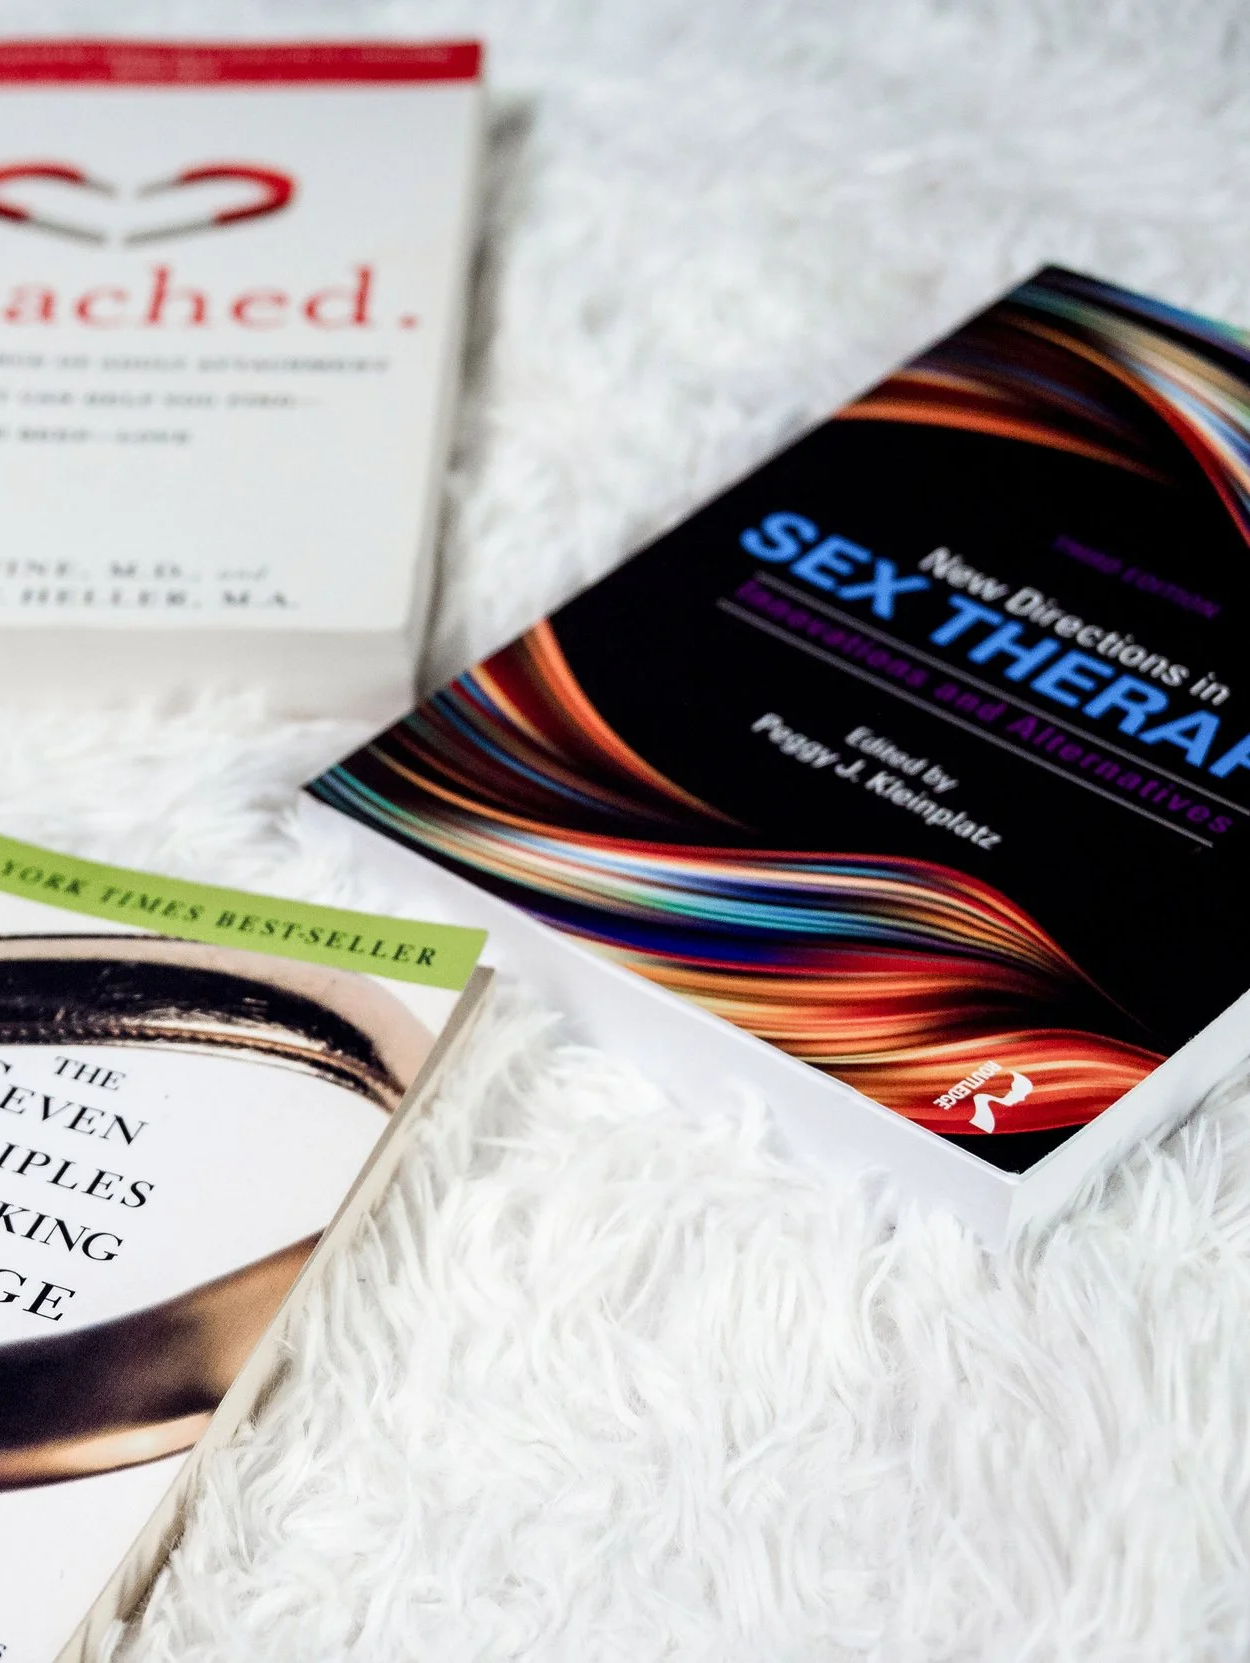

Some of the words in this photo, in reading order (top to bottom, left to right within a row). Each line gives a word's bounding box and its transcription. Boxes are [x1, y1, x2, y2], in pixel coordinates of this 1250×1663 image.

[739, 510, 932, 620] SEX
[918, 545, 1008, 601] New
[1004, 587, 1190, 689] Directions
[1189, 671, 1231, 707] in
[751, 712, 841, 769] Peggy
[834, 759, 867, 783] J.
[864, 770, 1003, 851] Kleinplatz
[844, 725, 929, 776] Edited
[921, 764, 959, 794] by
[933, 682, 1008, 724] and
[1006, 714, 1233, 834] Alternatives
[0, 857, 89, 898] YORK
[100, 886, 208, 923] TIMES
[214, 909, 438, 969] BEST-SELLER
[54, 1055, 127, 1092] THE
[933, 1060, 1003, 1110] ROUTLEDGE
